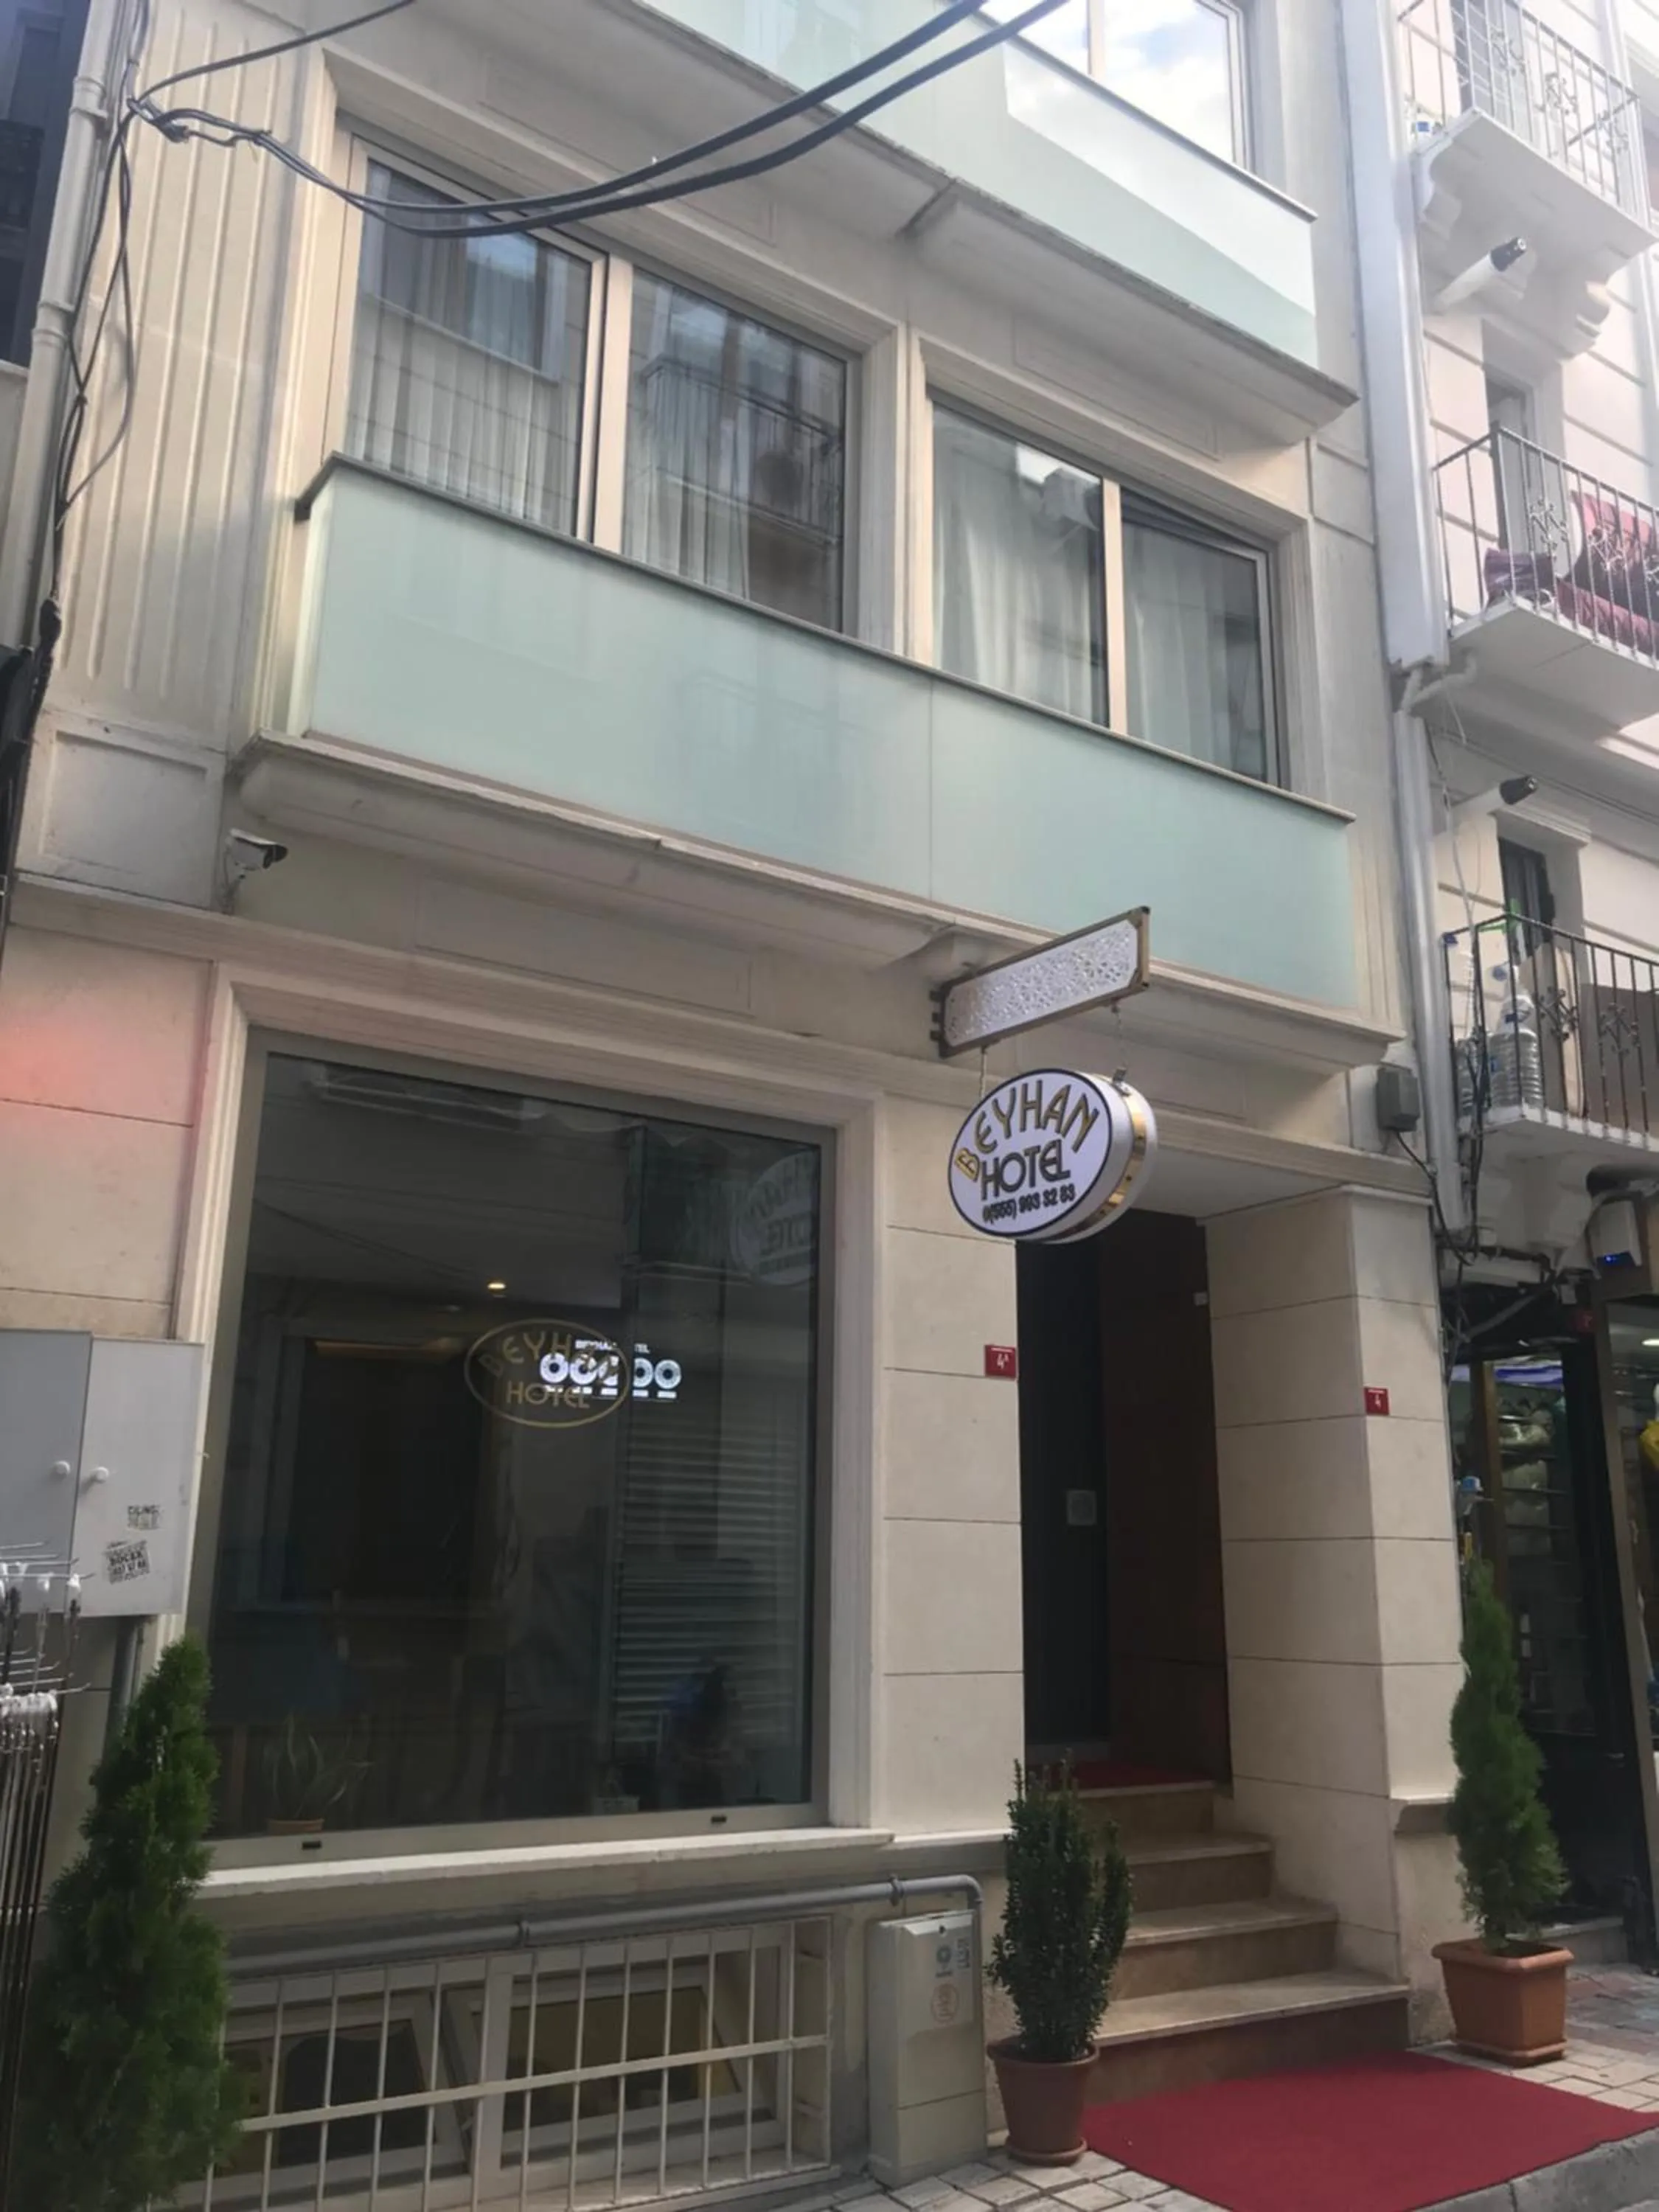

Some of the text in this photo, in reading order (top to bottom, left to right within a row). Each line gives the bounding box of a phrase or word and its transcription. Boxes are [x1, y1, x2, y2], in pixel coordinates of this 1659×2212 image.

[955, 1079, 1100, 1183] BEYHAN
[981, 1138, 1071, 1201] HOTEL
[507, 1380, 591, 1409] HOTEL
